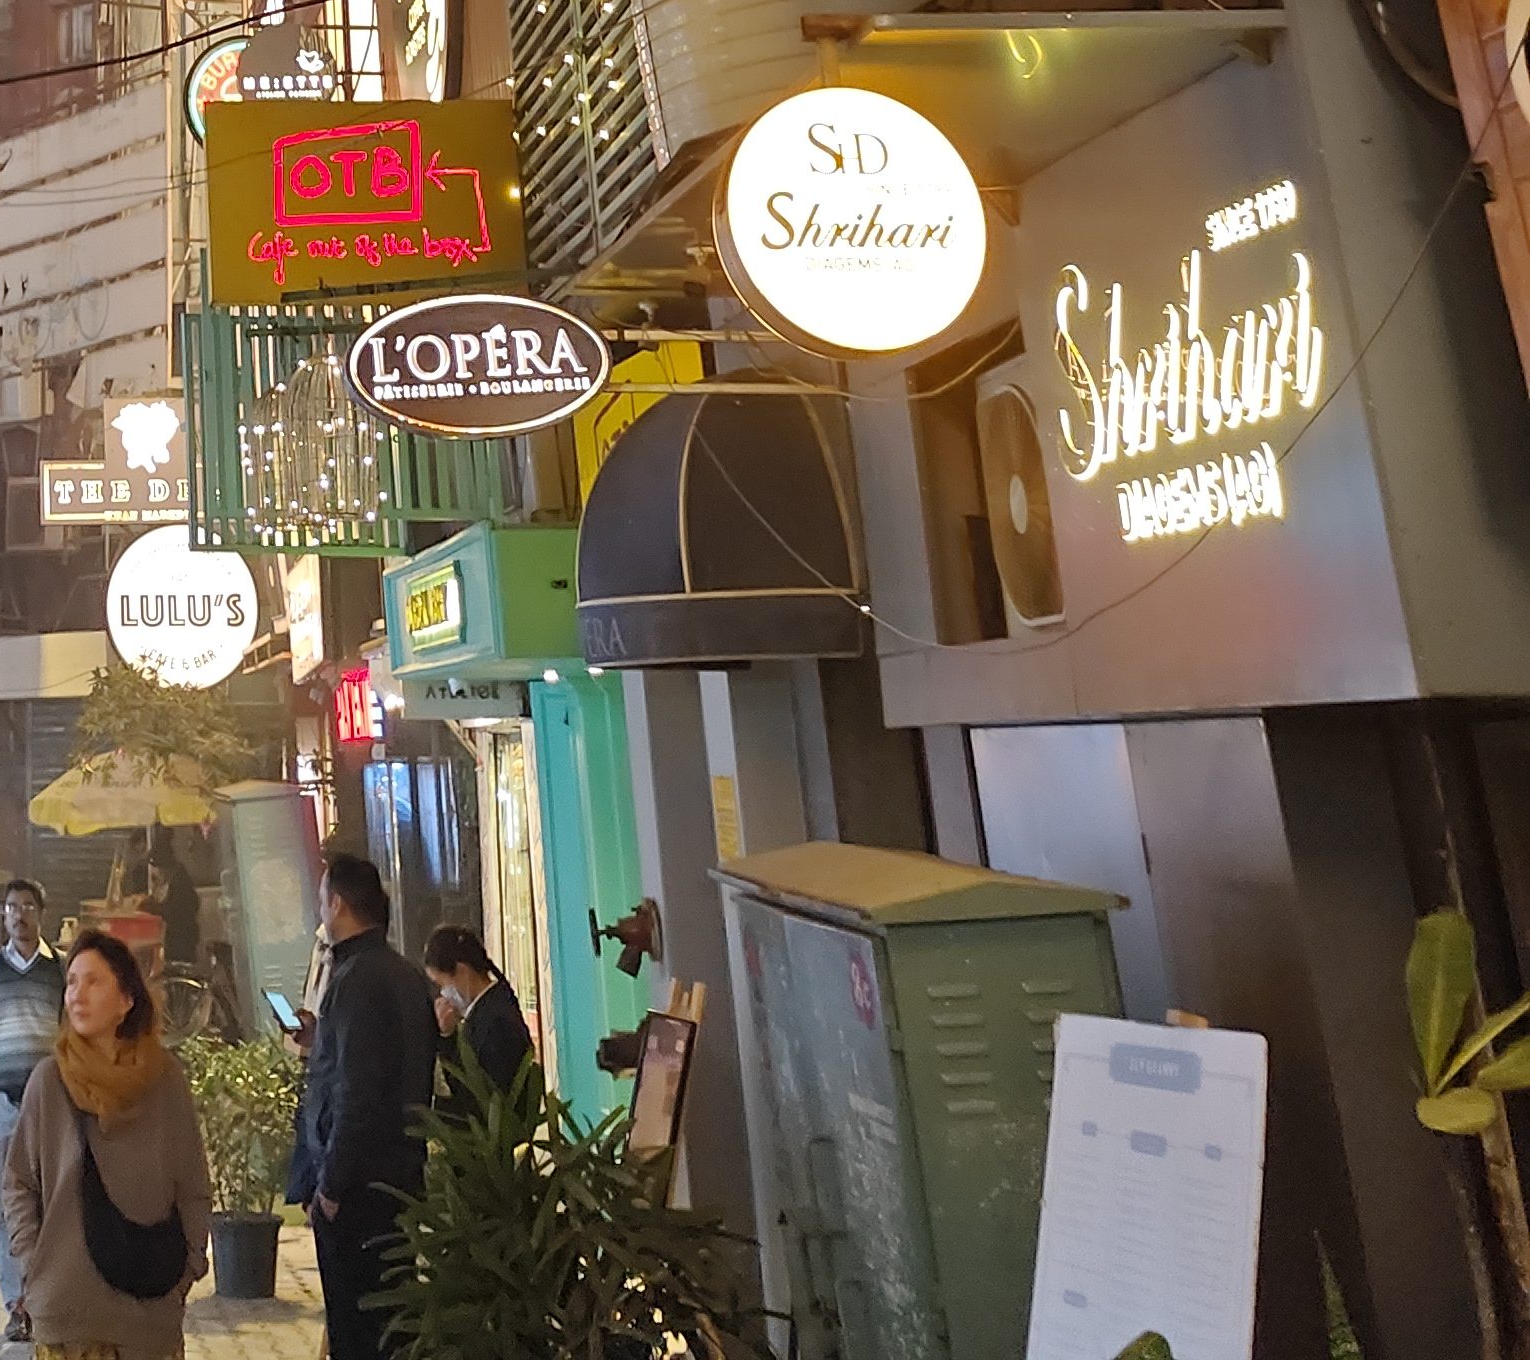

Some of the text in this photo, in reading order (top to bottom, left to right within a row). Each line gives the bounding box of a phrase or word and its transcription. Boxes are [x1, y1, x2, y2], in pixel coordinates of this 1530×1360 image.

[290, 146, 410, 199] OTB
[761, 191, 954, 251] Shrihari
[423, 227, 479, 268] box
[1058, 248, 1323, 481] Shrihari
[53, 479, 131, 504] THE
[120, 593, 245, 628] LULU'S
[194, 649, 217, 669] BAR
